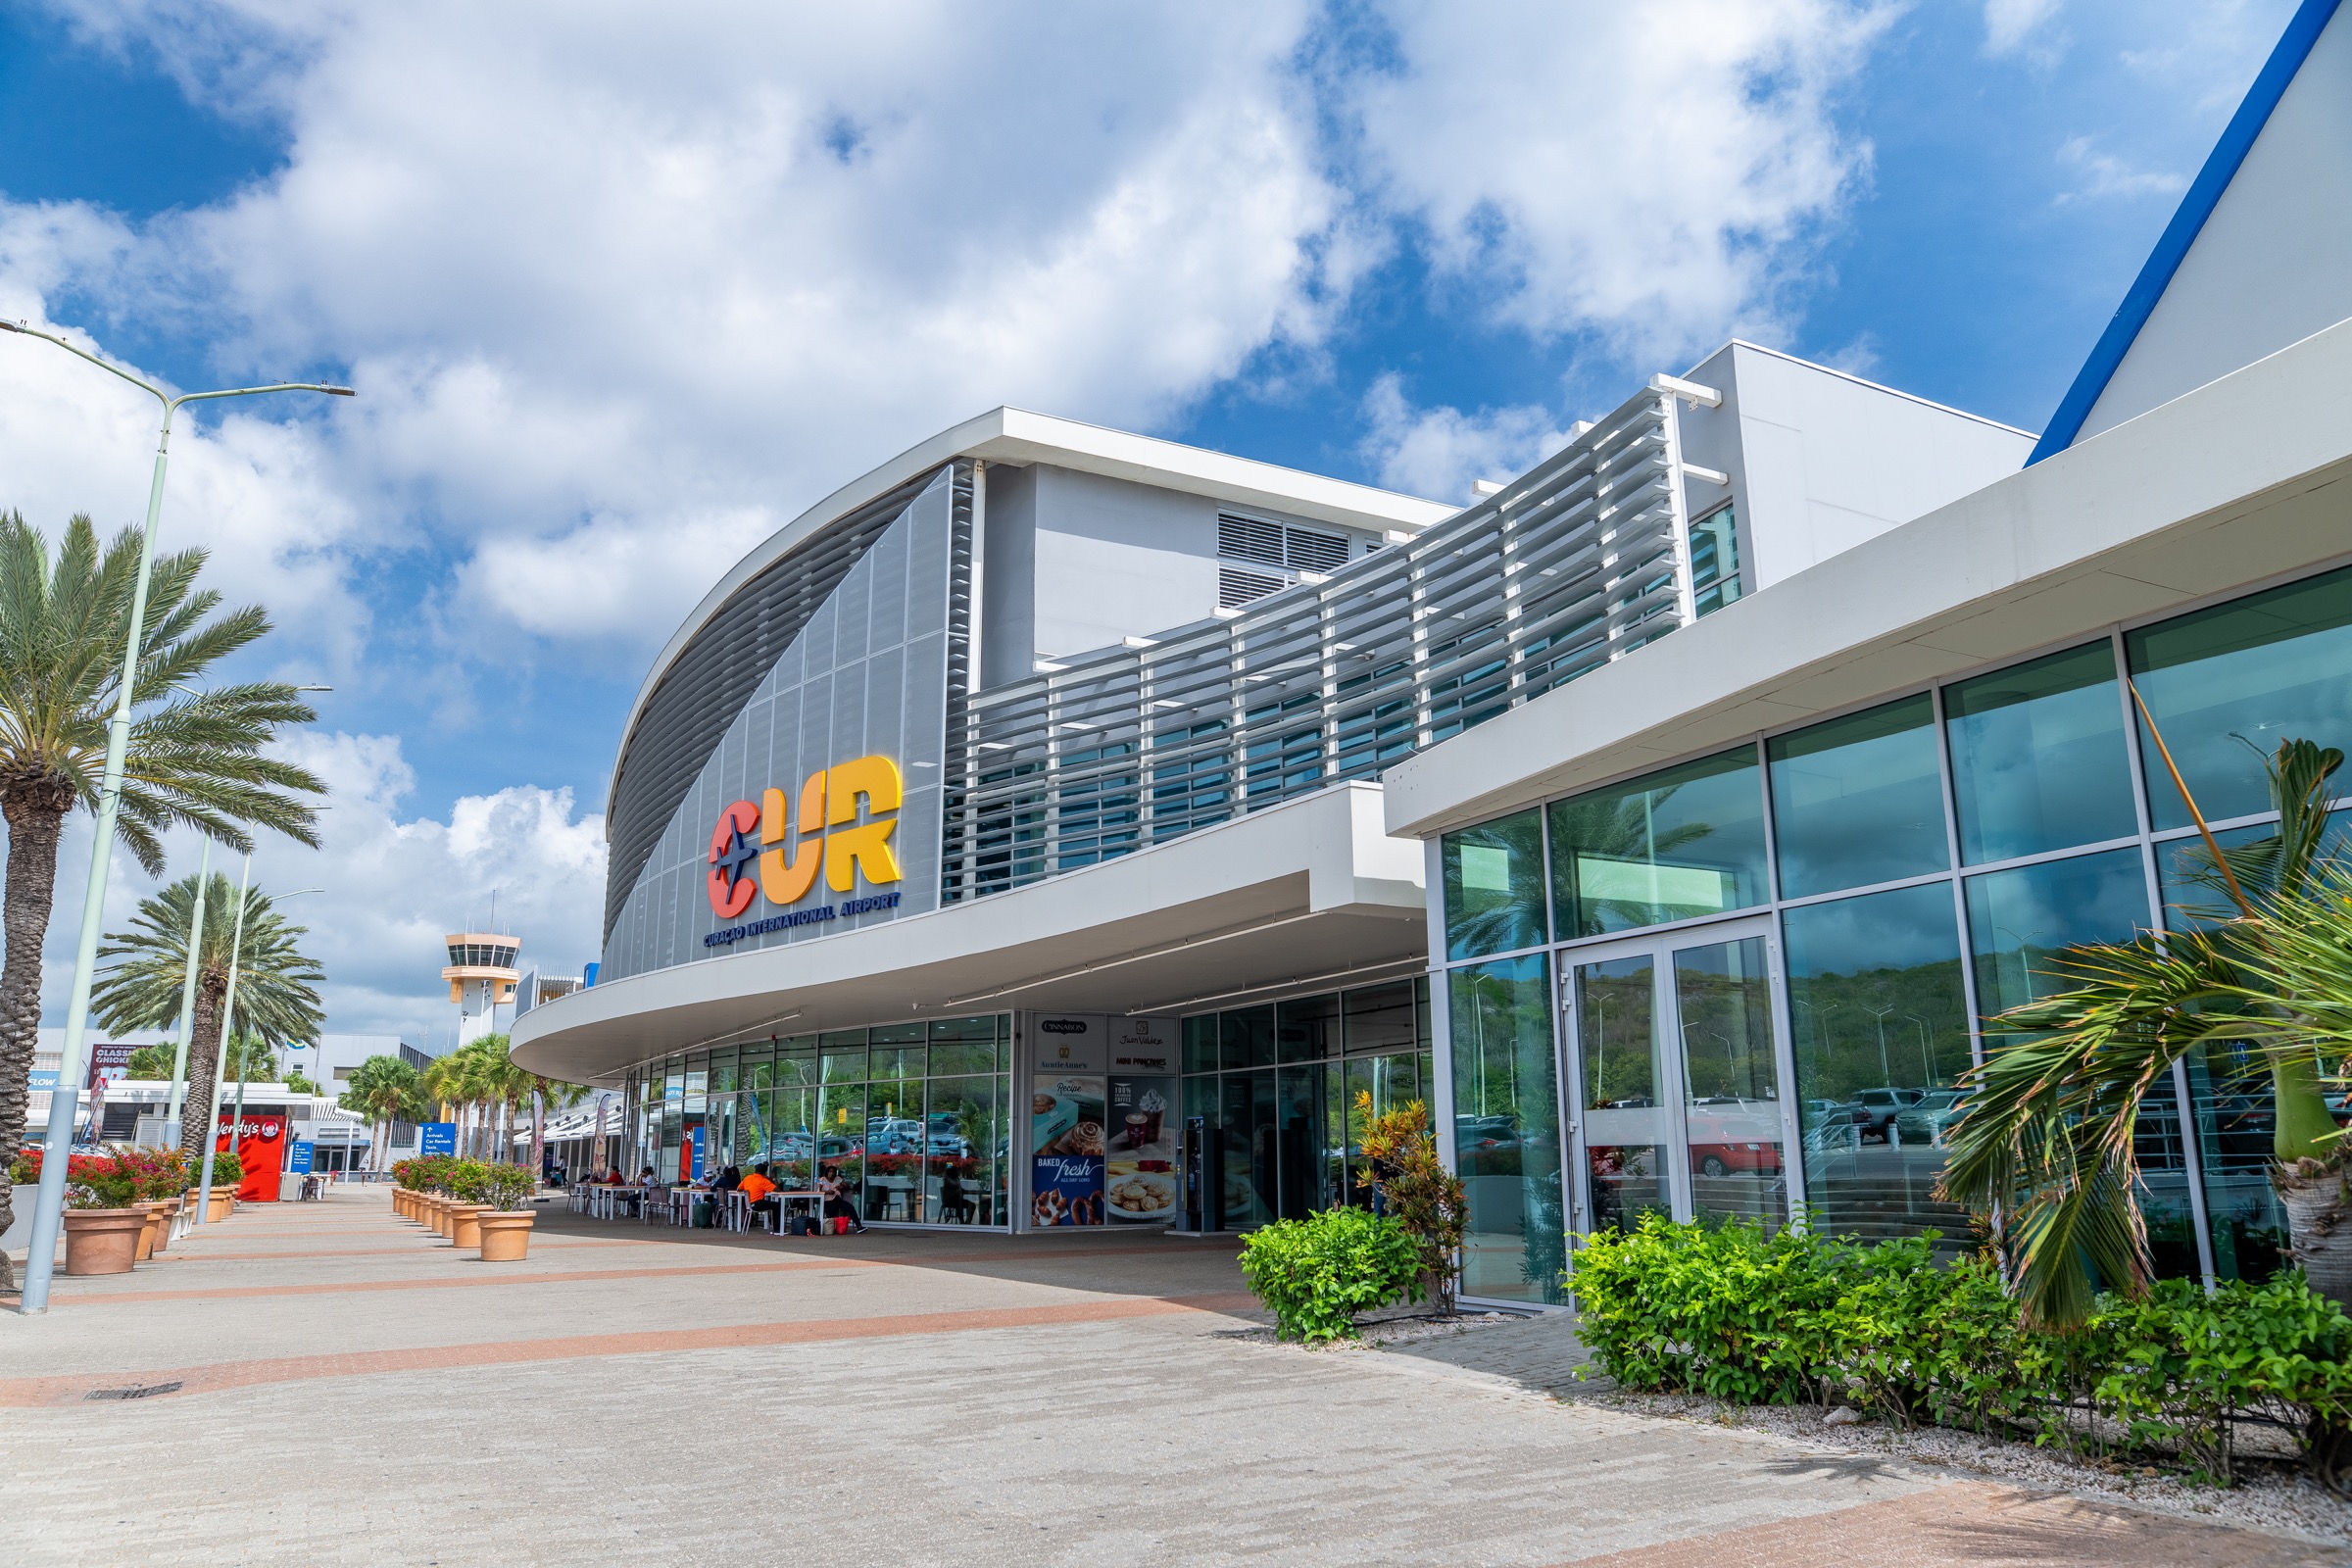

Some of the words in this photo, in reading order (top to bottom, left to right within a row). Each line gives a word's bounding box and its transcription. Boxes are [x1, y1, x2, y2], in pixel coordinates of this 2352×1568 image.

[708, 756, 903, 918] CUR
[704, 927, 746, 948] CURAÇAO
[747, 906, 836, 937] INTERNATIONAL
[840, 892, 901, 916] AIRPORT
[1044, 1022, 1084, 1032] CINNABON
[1119, 1035, 1139, 1045] Juan
[1139, 1036, 1164, 1046] Valdez
[1133, 1057, 1167, 1066] PANCAKES
[1056, 1082, 1082, 1094] Recipe
[1037, 1157, 1060, 1167] BAKED
[1053, 1158, 1102, 1182] fresh
